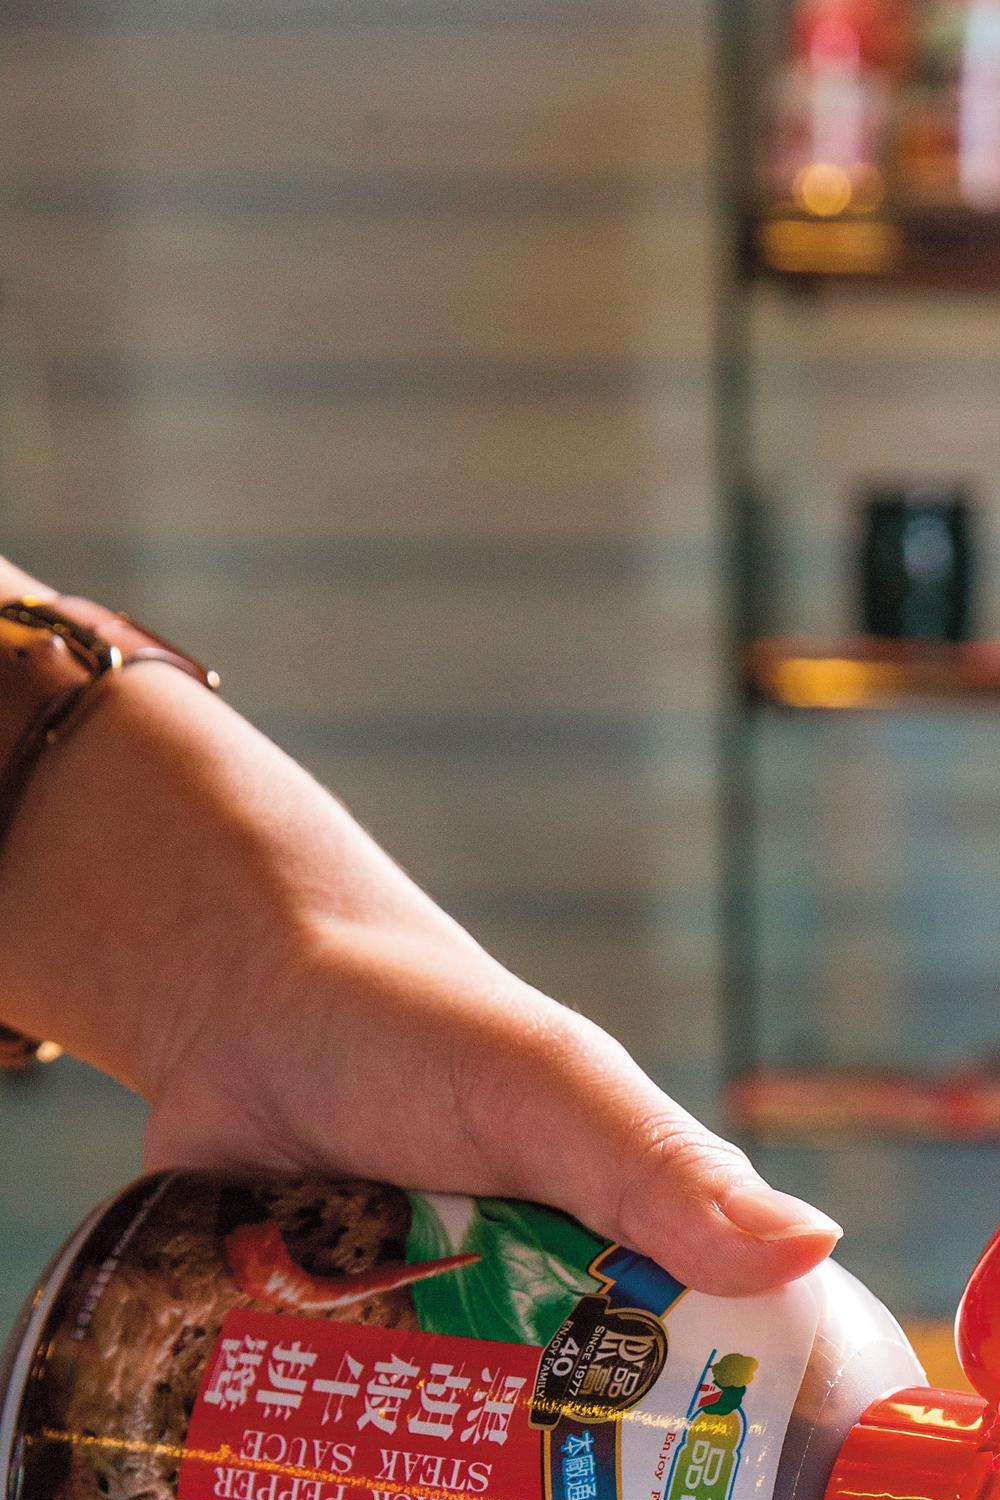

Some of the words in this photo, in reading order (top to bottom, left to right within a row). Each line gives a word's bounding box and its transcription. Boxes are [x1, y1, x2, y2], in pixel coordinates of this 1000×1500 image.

[550, 1319, 574, 1358] ENJOY
[552, 1337, 580, 1377] 40
[582, 1325, 606, 1361] SINCE
[203, 1334, 527, 1446] 黑胡椒牛排醬
[535, 1357, 553, 1398] FAMILY
[568, 1364, 587, 1397] 1977
[240, 1429, 356, 1473] SAUCE
[375, 1449, 493, 1492] STEAK
[654, 1432, 676, 1481] Enjoy
